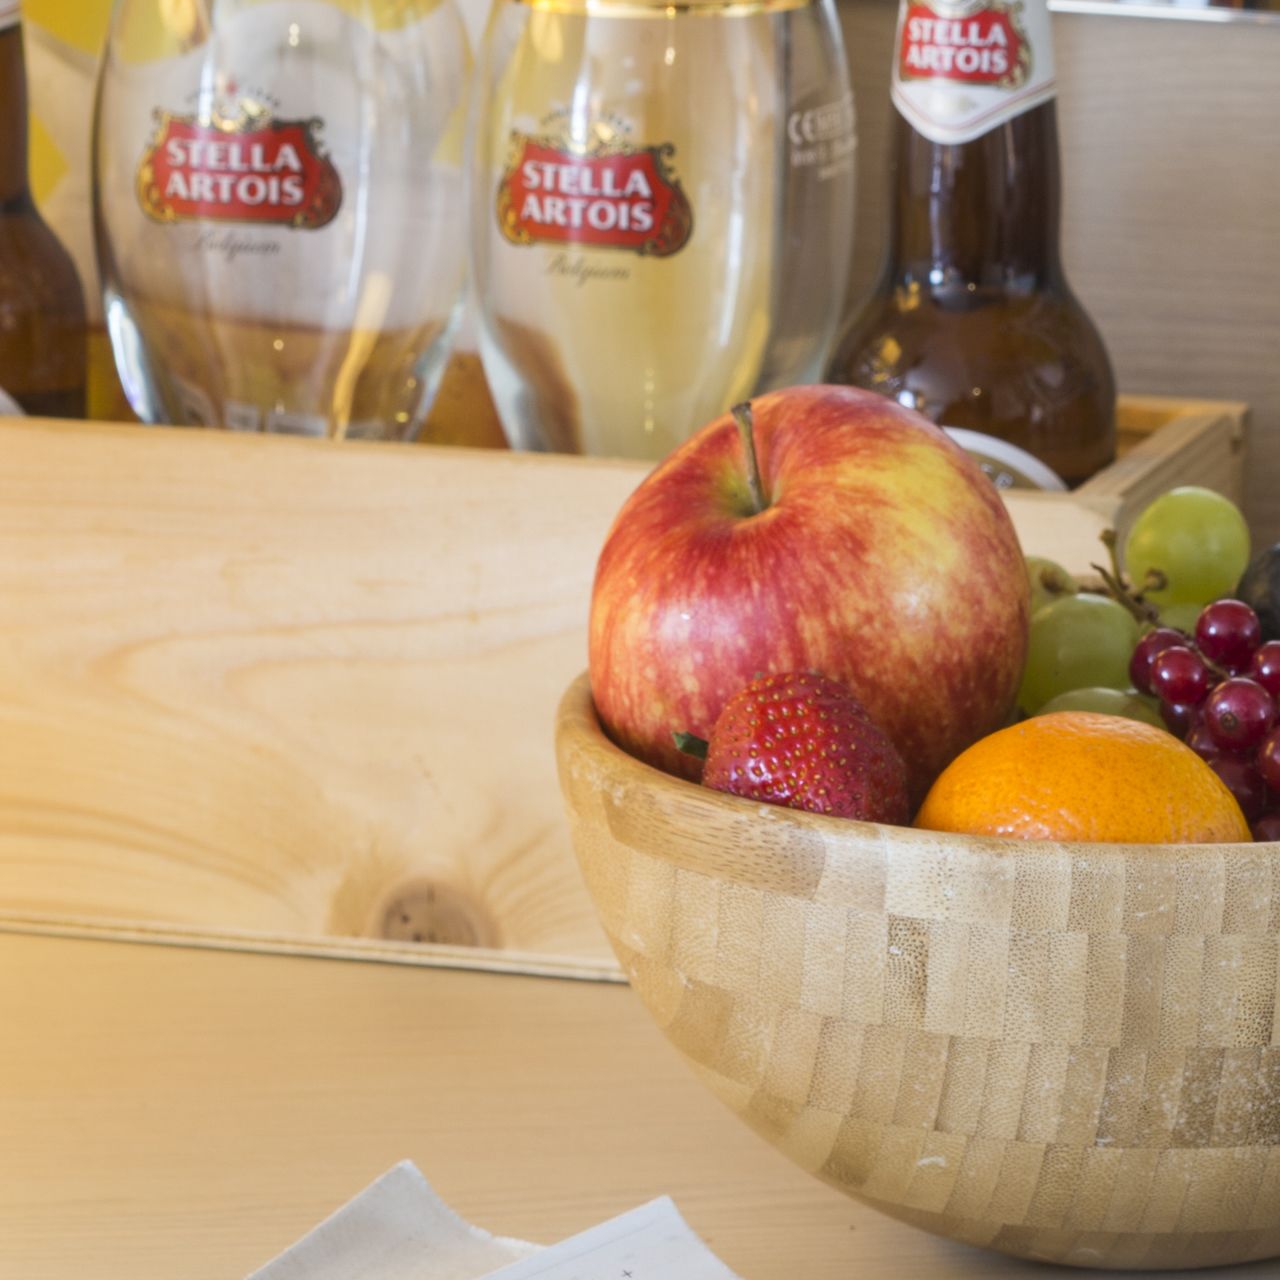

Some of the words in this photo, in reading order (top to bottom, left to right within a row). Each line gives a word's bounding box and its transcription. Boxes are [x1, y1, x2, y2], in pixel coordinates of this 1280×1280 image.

[908, 17, 1006, 47] STELLA
[905, 46, 1008, 74] ARTOIS
[166, 137, 302, 172] STELLA
[165, 171, 304, 206] ARTOIS
[521, 160, 653, 198] STELLA
[520, 193, 654, 232] ARTOIS
